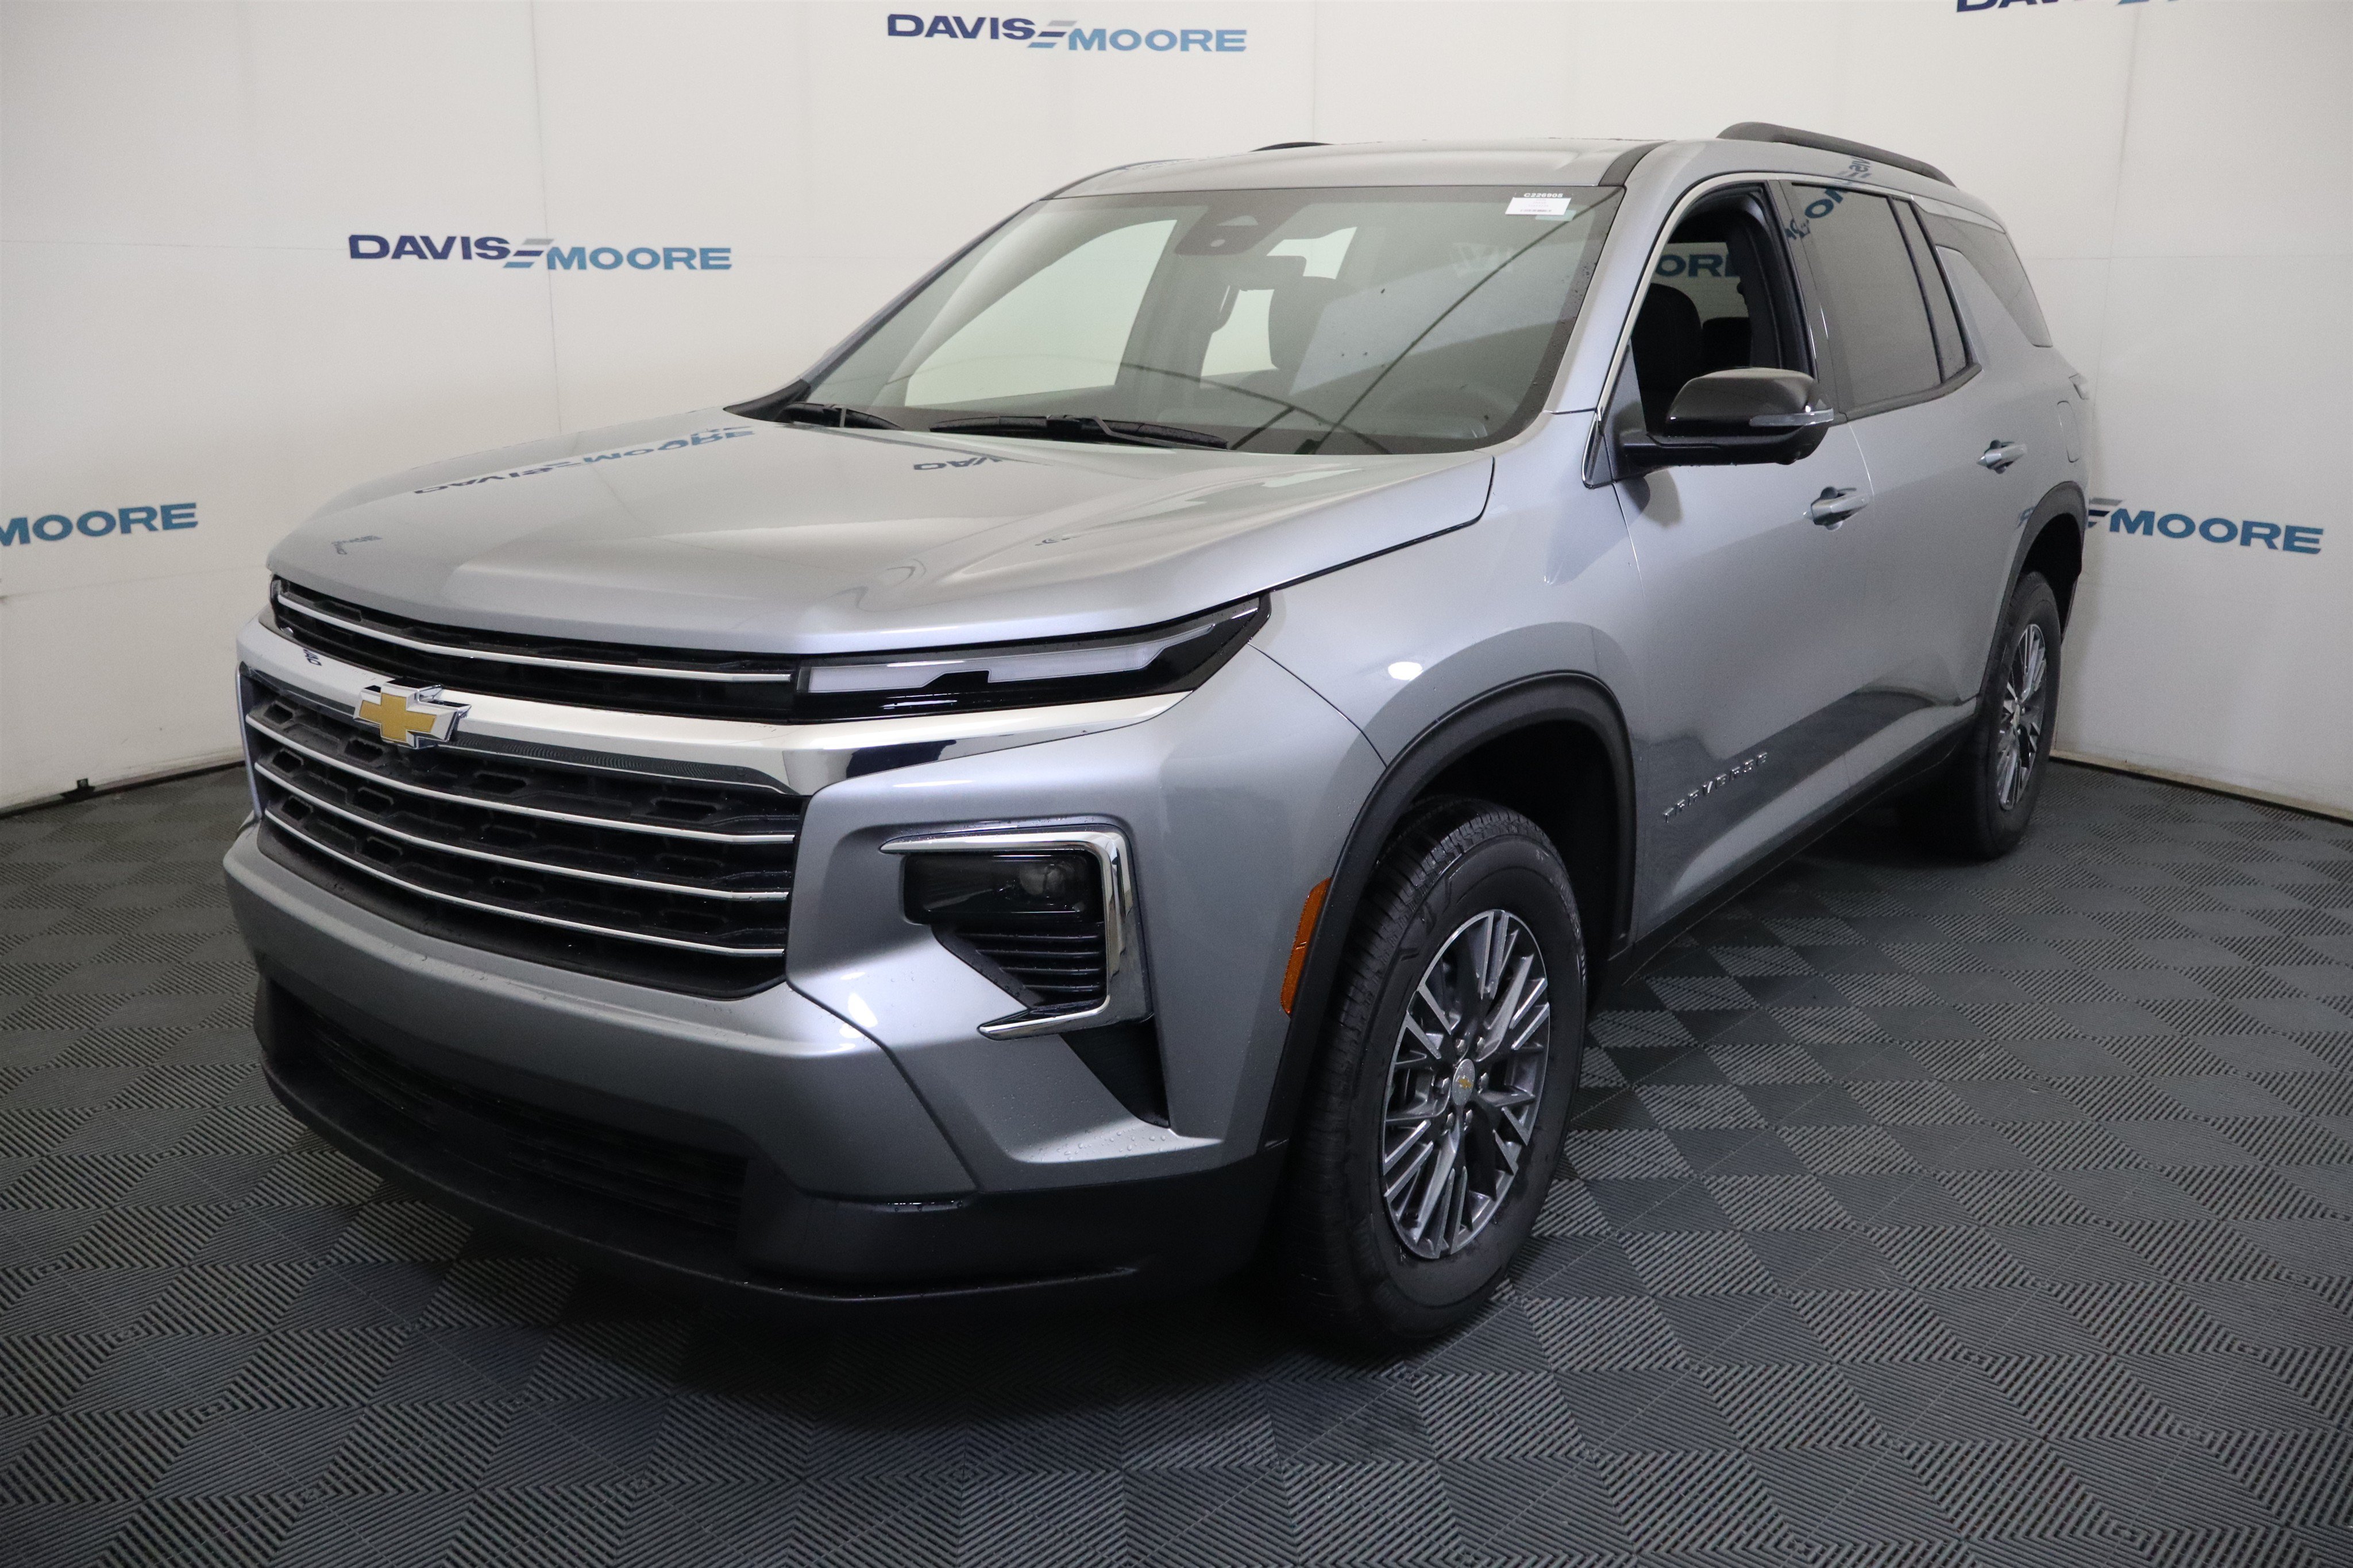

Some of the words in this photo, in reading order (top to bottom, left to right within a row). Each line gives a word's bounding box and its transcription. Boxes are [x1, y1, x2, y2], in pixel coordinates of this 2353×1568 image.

[887, 13, 1036, 40] DAVIS
[1068, 27, 1248, 52] MOORE
[348, 234, 511, 260] DAVIS
[546, 246, 732, 271] MOORE
[2109, 508, 2324, 555] MOORE
